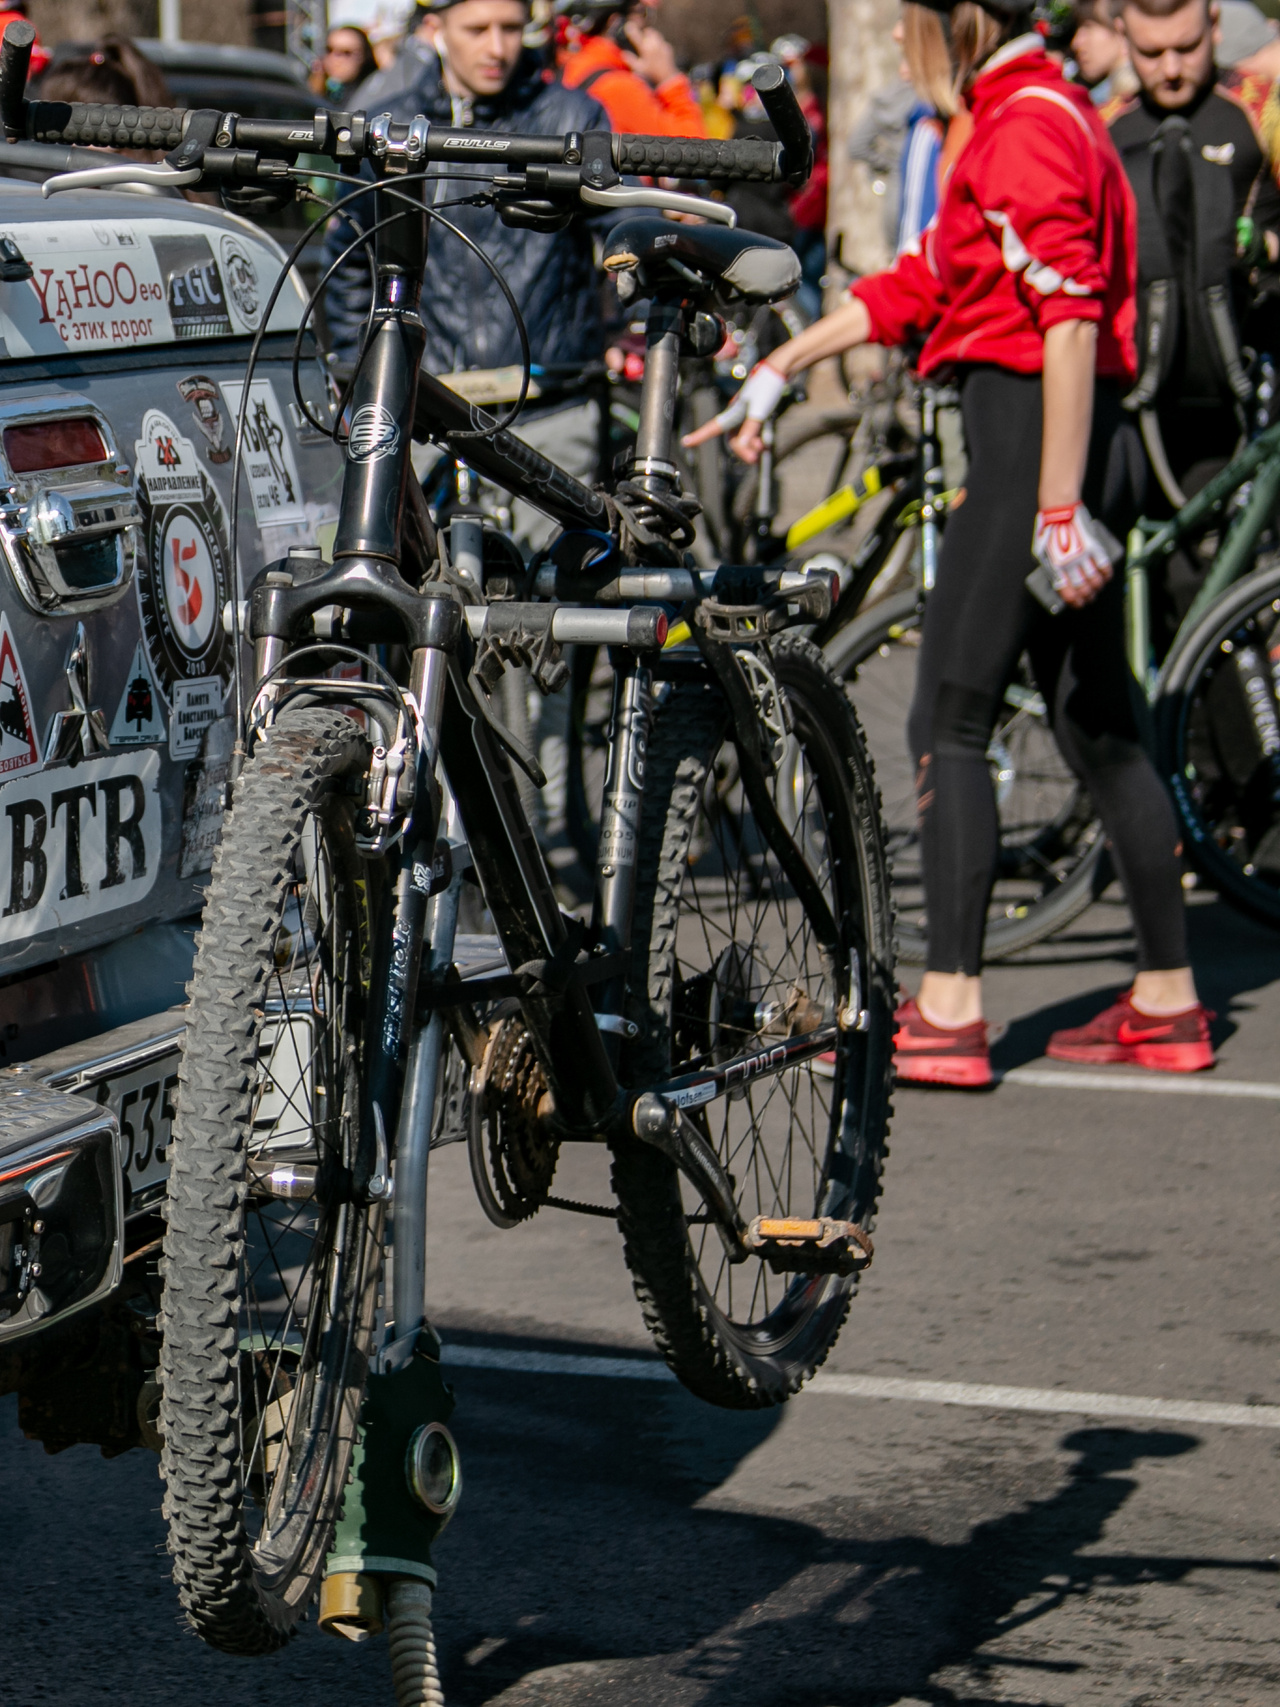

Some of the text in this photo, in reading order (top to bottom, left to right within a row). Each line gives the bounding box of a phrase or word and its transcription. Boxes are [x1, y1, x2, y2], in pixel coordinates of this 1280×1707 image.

[443, 137, 511, 151] BULLS
[72, 320, 107, 340] этих
[111, 318, 153, 343] дорог
[147, 475, 200, 491] НАПРАВЛЕНИЕ
[186, 661, 206, 675] 2010
[2, 774, 147, 918] BTR
